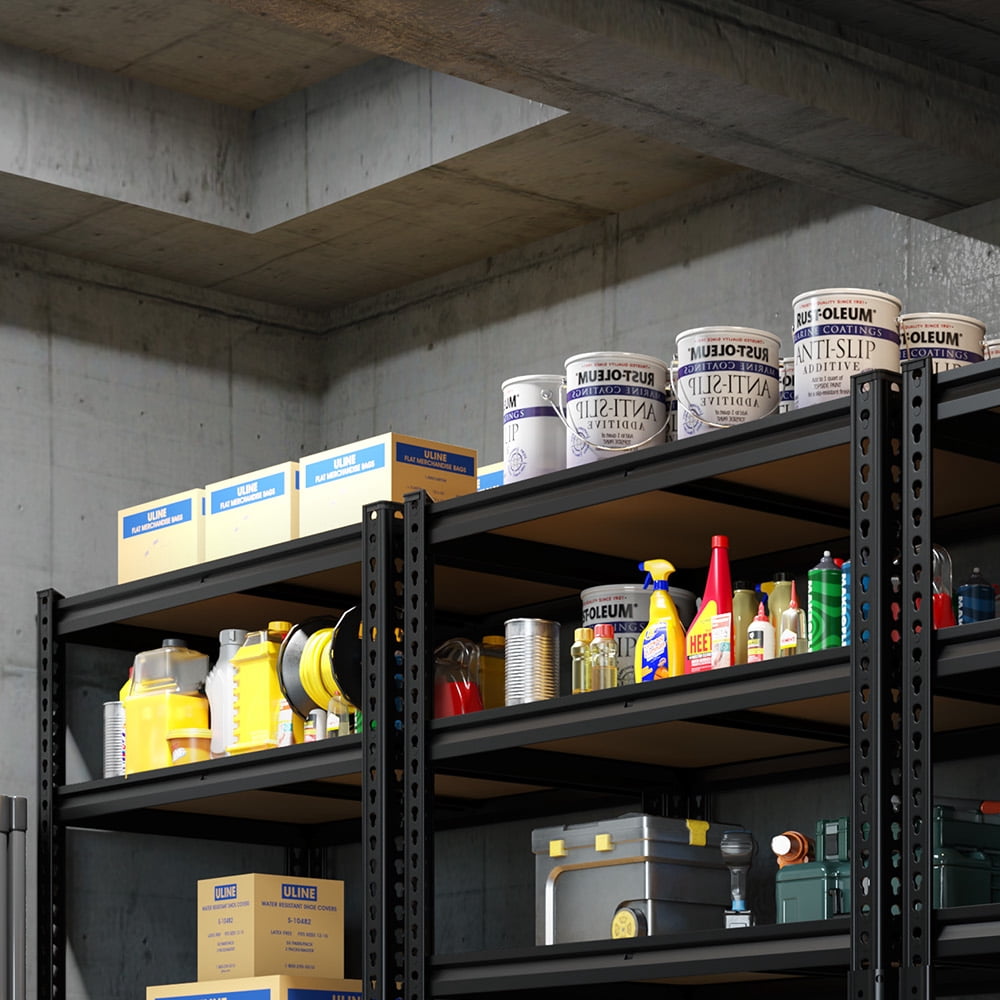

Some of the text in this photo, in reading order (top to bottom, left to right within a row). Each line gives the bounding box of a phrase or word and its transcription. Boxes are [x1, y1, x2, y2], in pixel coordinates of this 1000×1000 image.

[823, 325, 882, 336] COATINGS
[797, 338, 876, 365] ANTI-SLIP
[911, 349, 969, 360] COATINGS
[803, 361, 861, 375] ADDITIVE
[333, 453, 357, 469] ULINE
[424, 449, 447, 462] ULINE
[236, 481, 259, 497] ULINE
[147, 508, 168, 521] ULINE
[215, 885, 237, 899] ULINE
[284, 886, 316, 899] ULINE
[279, 902, 303, 910] RESISTANT
